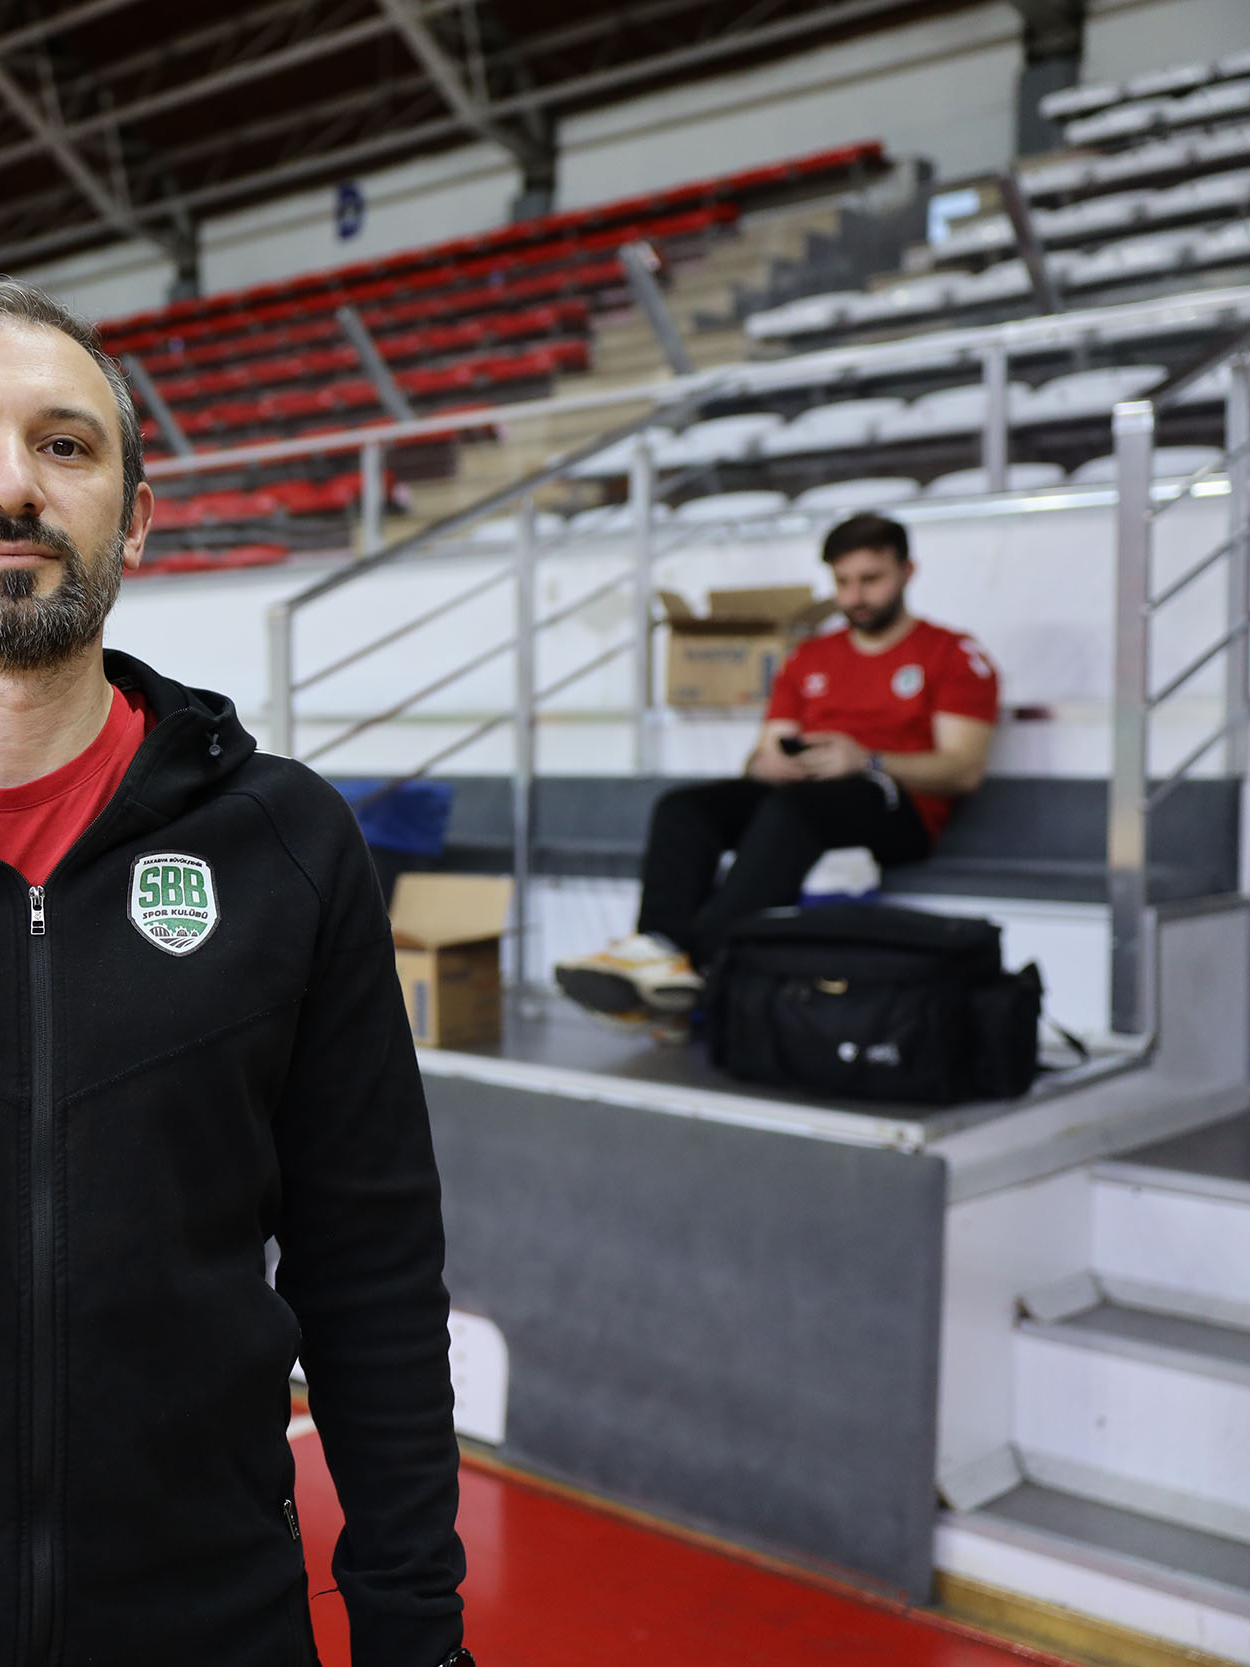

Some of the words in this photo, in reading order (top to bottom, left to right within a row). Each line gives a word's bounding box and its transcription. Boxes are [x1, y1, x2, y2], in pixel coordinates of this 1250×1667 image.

[138, 865, 208, 908] SBB
[142, 909, 168, 919] SPOR
[171, 908, 208, 919] KULÜBÜ
